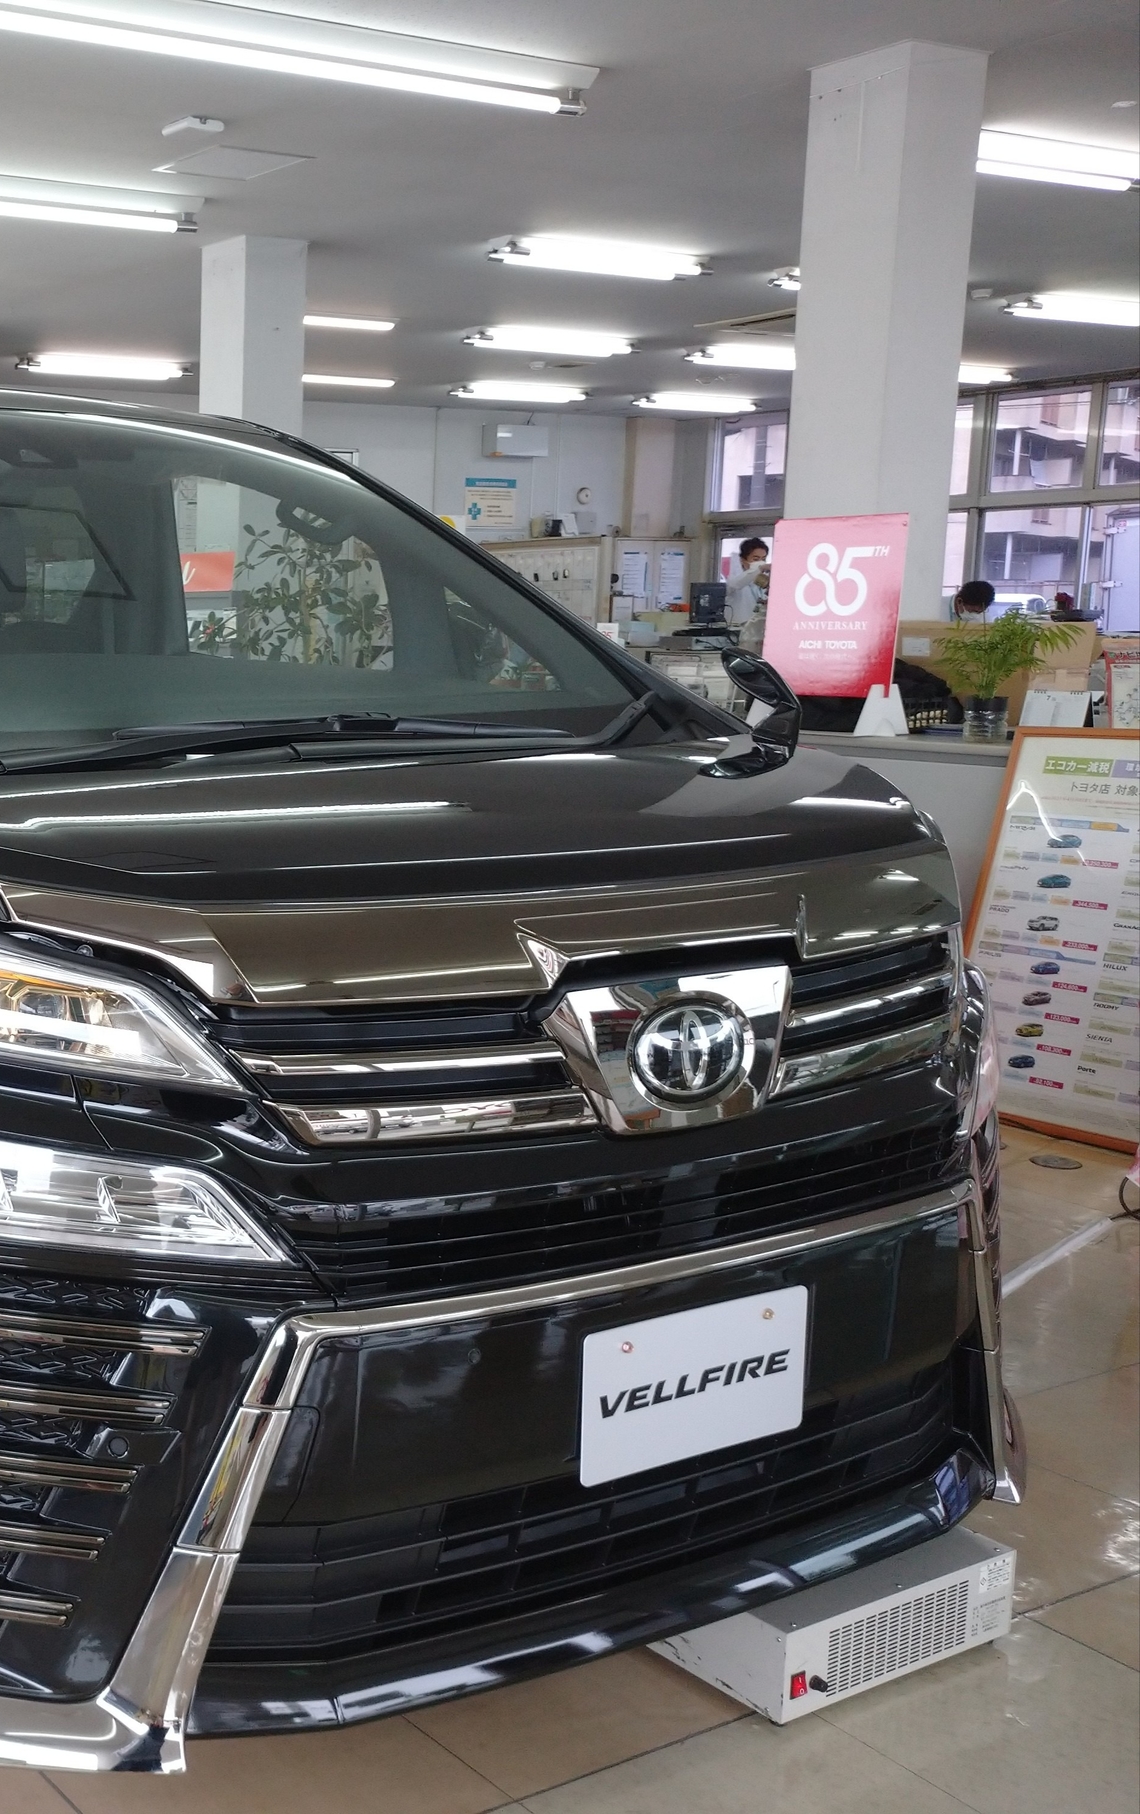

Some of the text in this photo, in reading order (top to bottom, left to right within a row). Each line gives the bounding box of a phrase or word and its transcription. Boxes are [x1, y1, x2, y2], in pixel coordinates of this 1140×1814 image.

[792, 620, 869, 631] ANNIVERSARY
[798, 640, 858, 650] AICHI TOYOTA
[1045, 759, 1111, 774] エコカー減税
[1070, 781, 1139, 797] トヨタ店 対象
[1076, 1064, 1097, 1075] Porte
[598, 1348, 791, 1420] VELLFIRE
